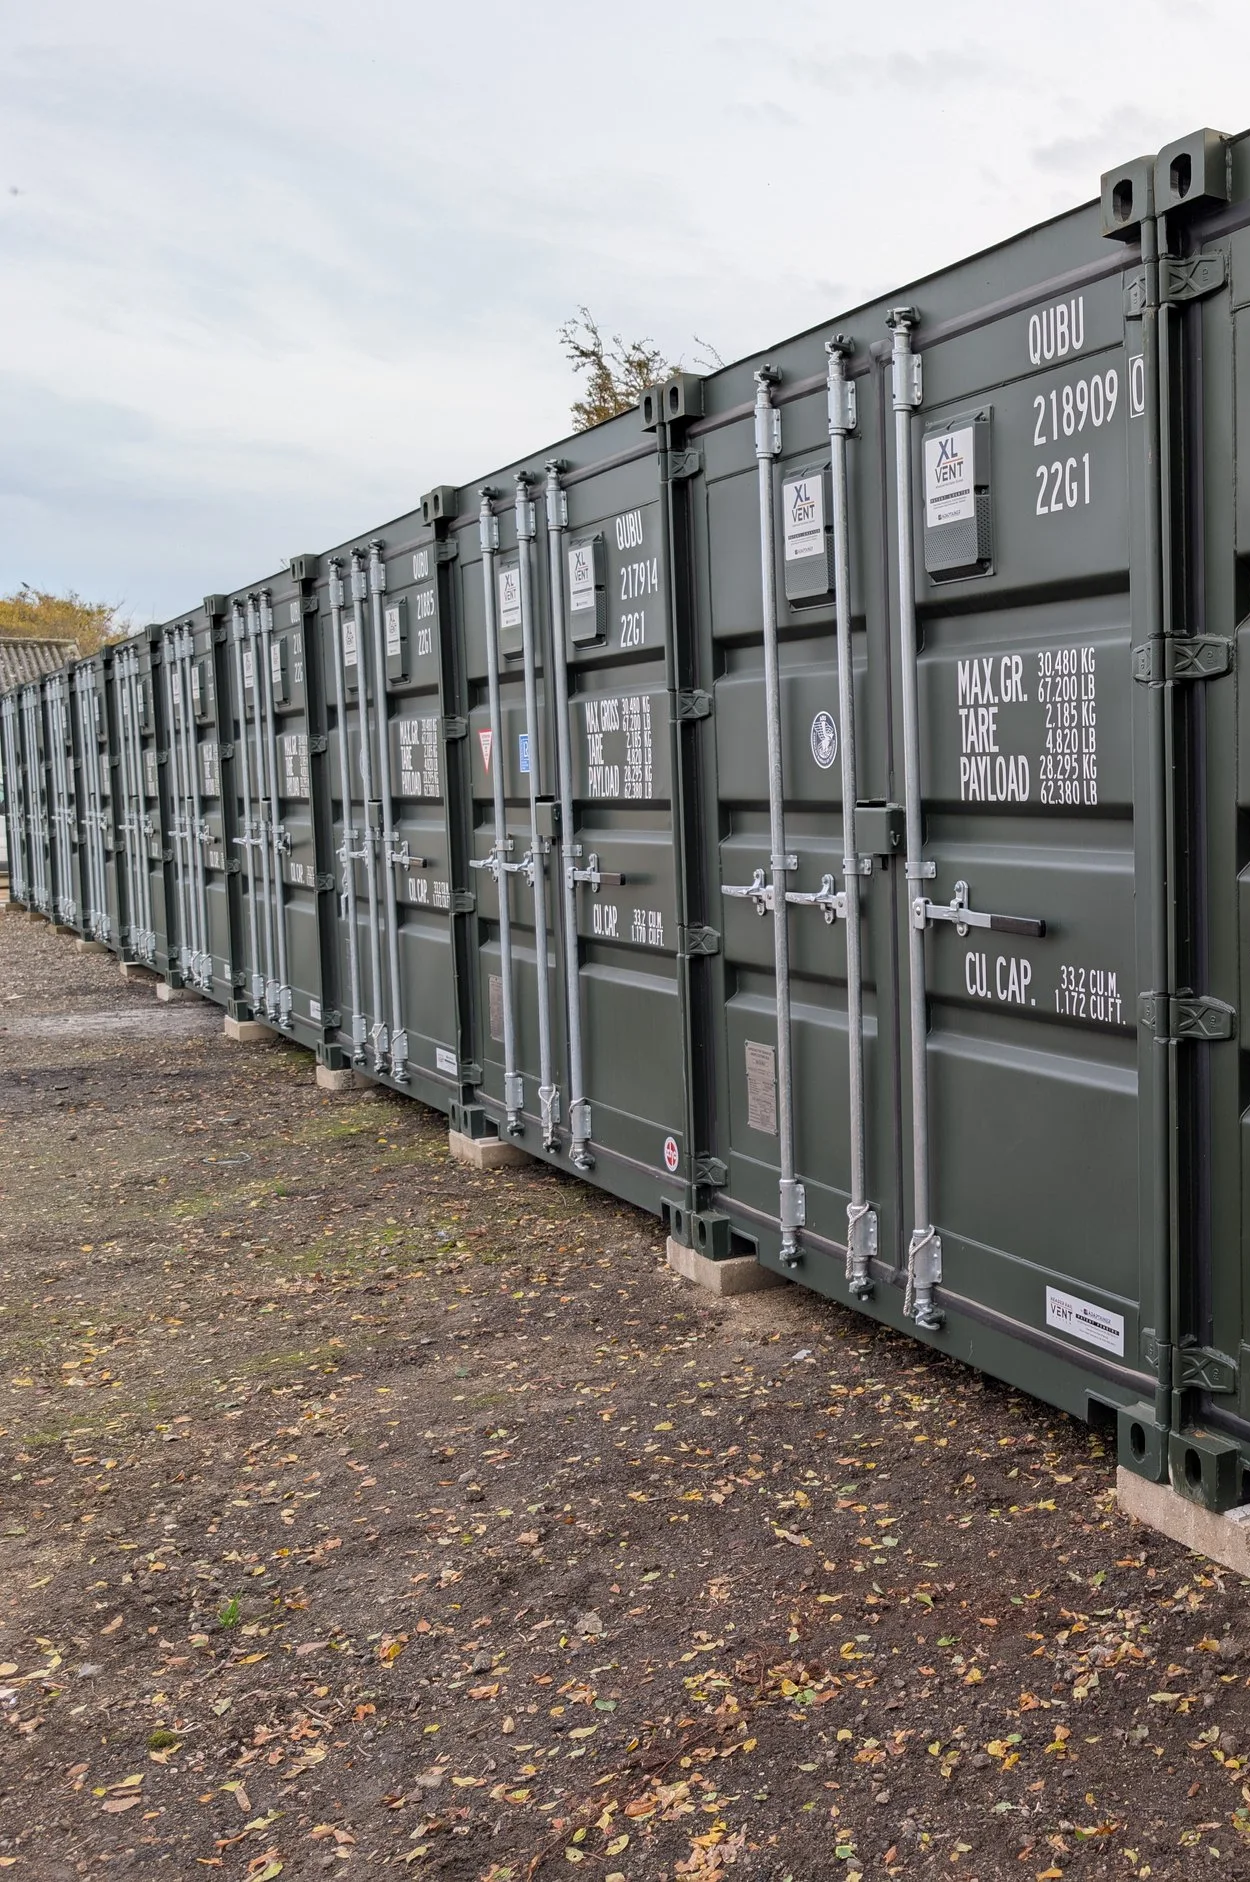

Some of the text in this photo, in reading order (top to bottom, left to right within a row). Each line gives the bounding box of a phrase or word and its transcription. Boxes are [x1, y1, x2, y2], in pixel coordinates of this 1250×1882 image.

[1028, 296, 1085, 366] QUBU
[1032, 369, 1119, 447] 218909
[937, 437, 958, 468] XL
[935, 461, 964, 483] VENT
[1036, 452, 1091, 516] 22G1
[793, 483, 810, 509] XL
[792, 504, 815, 523] VENT
[616, 510, 643, 550] QUBU
[621, 558, 658, 600] 217914
[621, 611, 645, 648] 22G1
[1037, 647, 1095, 677] 30,480 KG
[957, 654, 1027, 705] MAX. GR.
[1038, 674, 1095, 702] 67,200 LB
[642, 696, 651, 713] KG
[1046, 701, 1096, 727] 2,185 KG
[643, 713, 651, 730] LB
[958, 707, 999, 753] TARE
[587, 733, 604, 765] TARE
[644, 731, 652, 747] KG
[1046, 728, 1096, 753] 4,820 LB
[644, 748, 652, 764] LB
[1039, 754, 1097, 780] 28,295 KG
[588, 765, 620, 797] PAYLOAD
[644, 765, 652, 782] KG
[960, 755, 1030, 801] PAYLOAD
[645, 782, 652, 799] LB
[1083, 780, 1098, 805] LB
[965, 952, 1036, 1006] CU. CAP.
[1060, 965, 1121, 998] 33.2 CU.M.
[1055, 989, 1126, 1025] 1,172 CU.FT.
[1051, 1304, 1073, 1321] VENT
